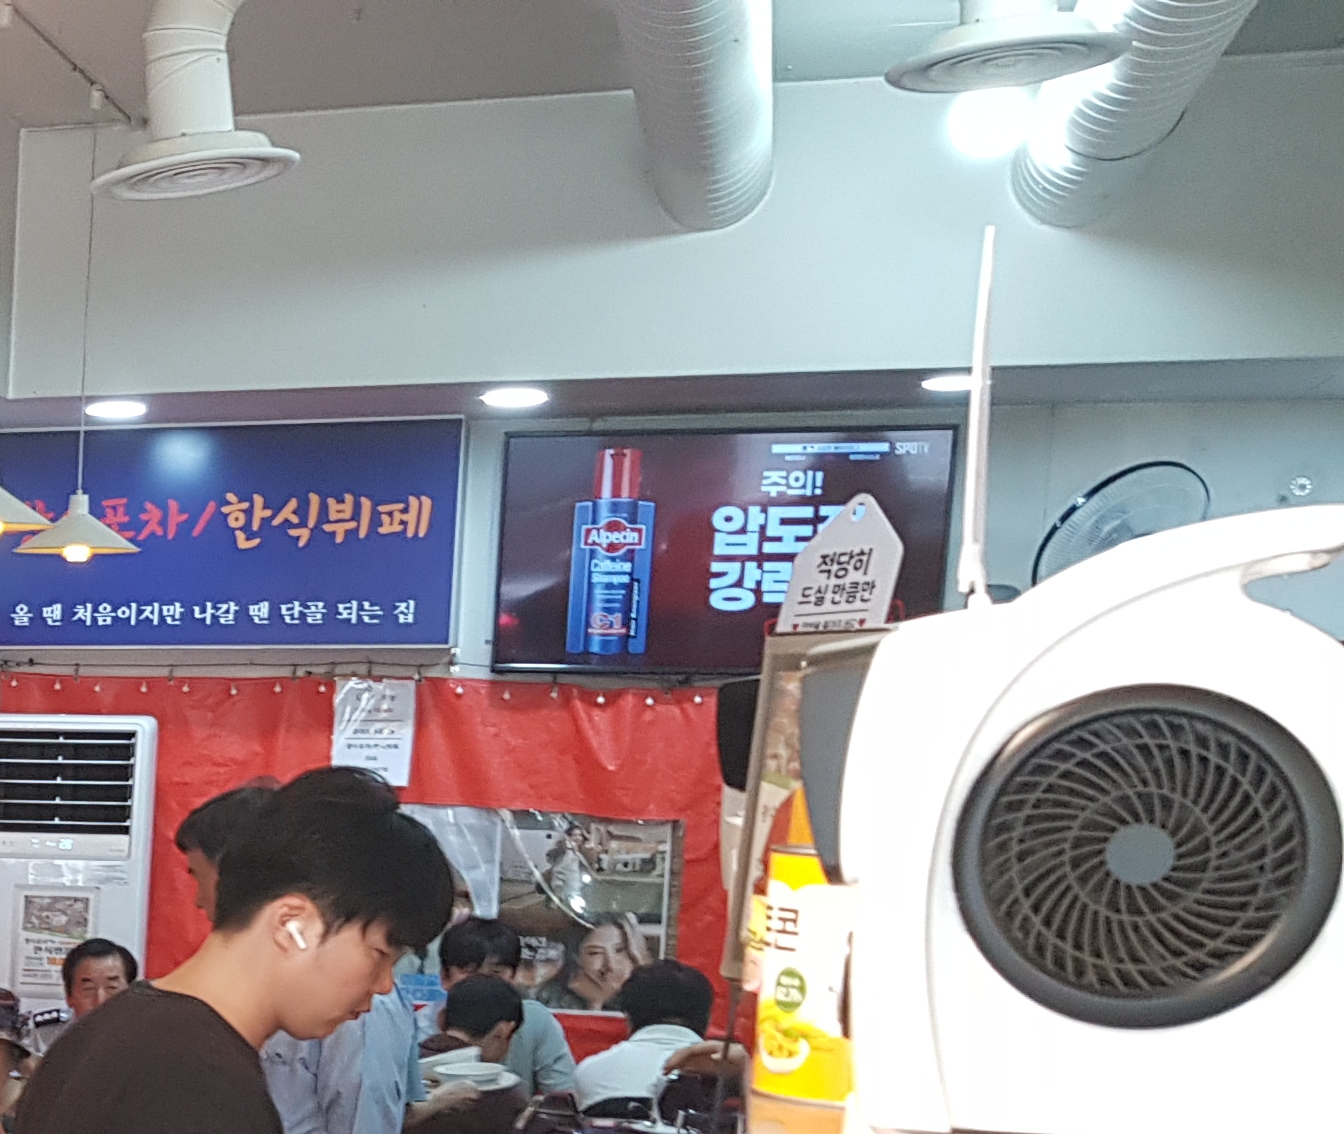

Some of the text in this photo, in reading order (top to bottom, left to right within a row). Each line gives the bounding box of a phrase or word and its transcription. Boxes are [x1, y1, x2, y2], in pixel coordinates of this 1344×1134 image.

[761, 470, 824, 497] 주의!
[587, 528, 639, 547] Alpecin
[817, 548, 873, 579] 적당히
[11, 603, 33, 625] 올
[72, 602, 185, 626] 처음이지만
[192, 602, 239, 625] 나갈
[249, 602, 269, 624] 땐
[280, 601, 327, 624] 단골
[336, 601, 384, 624] 되는
[393, 601, 415, 624] 집
